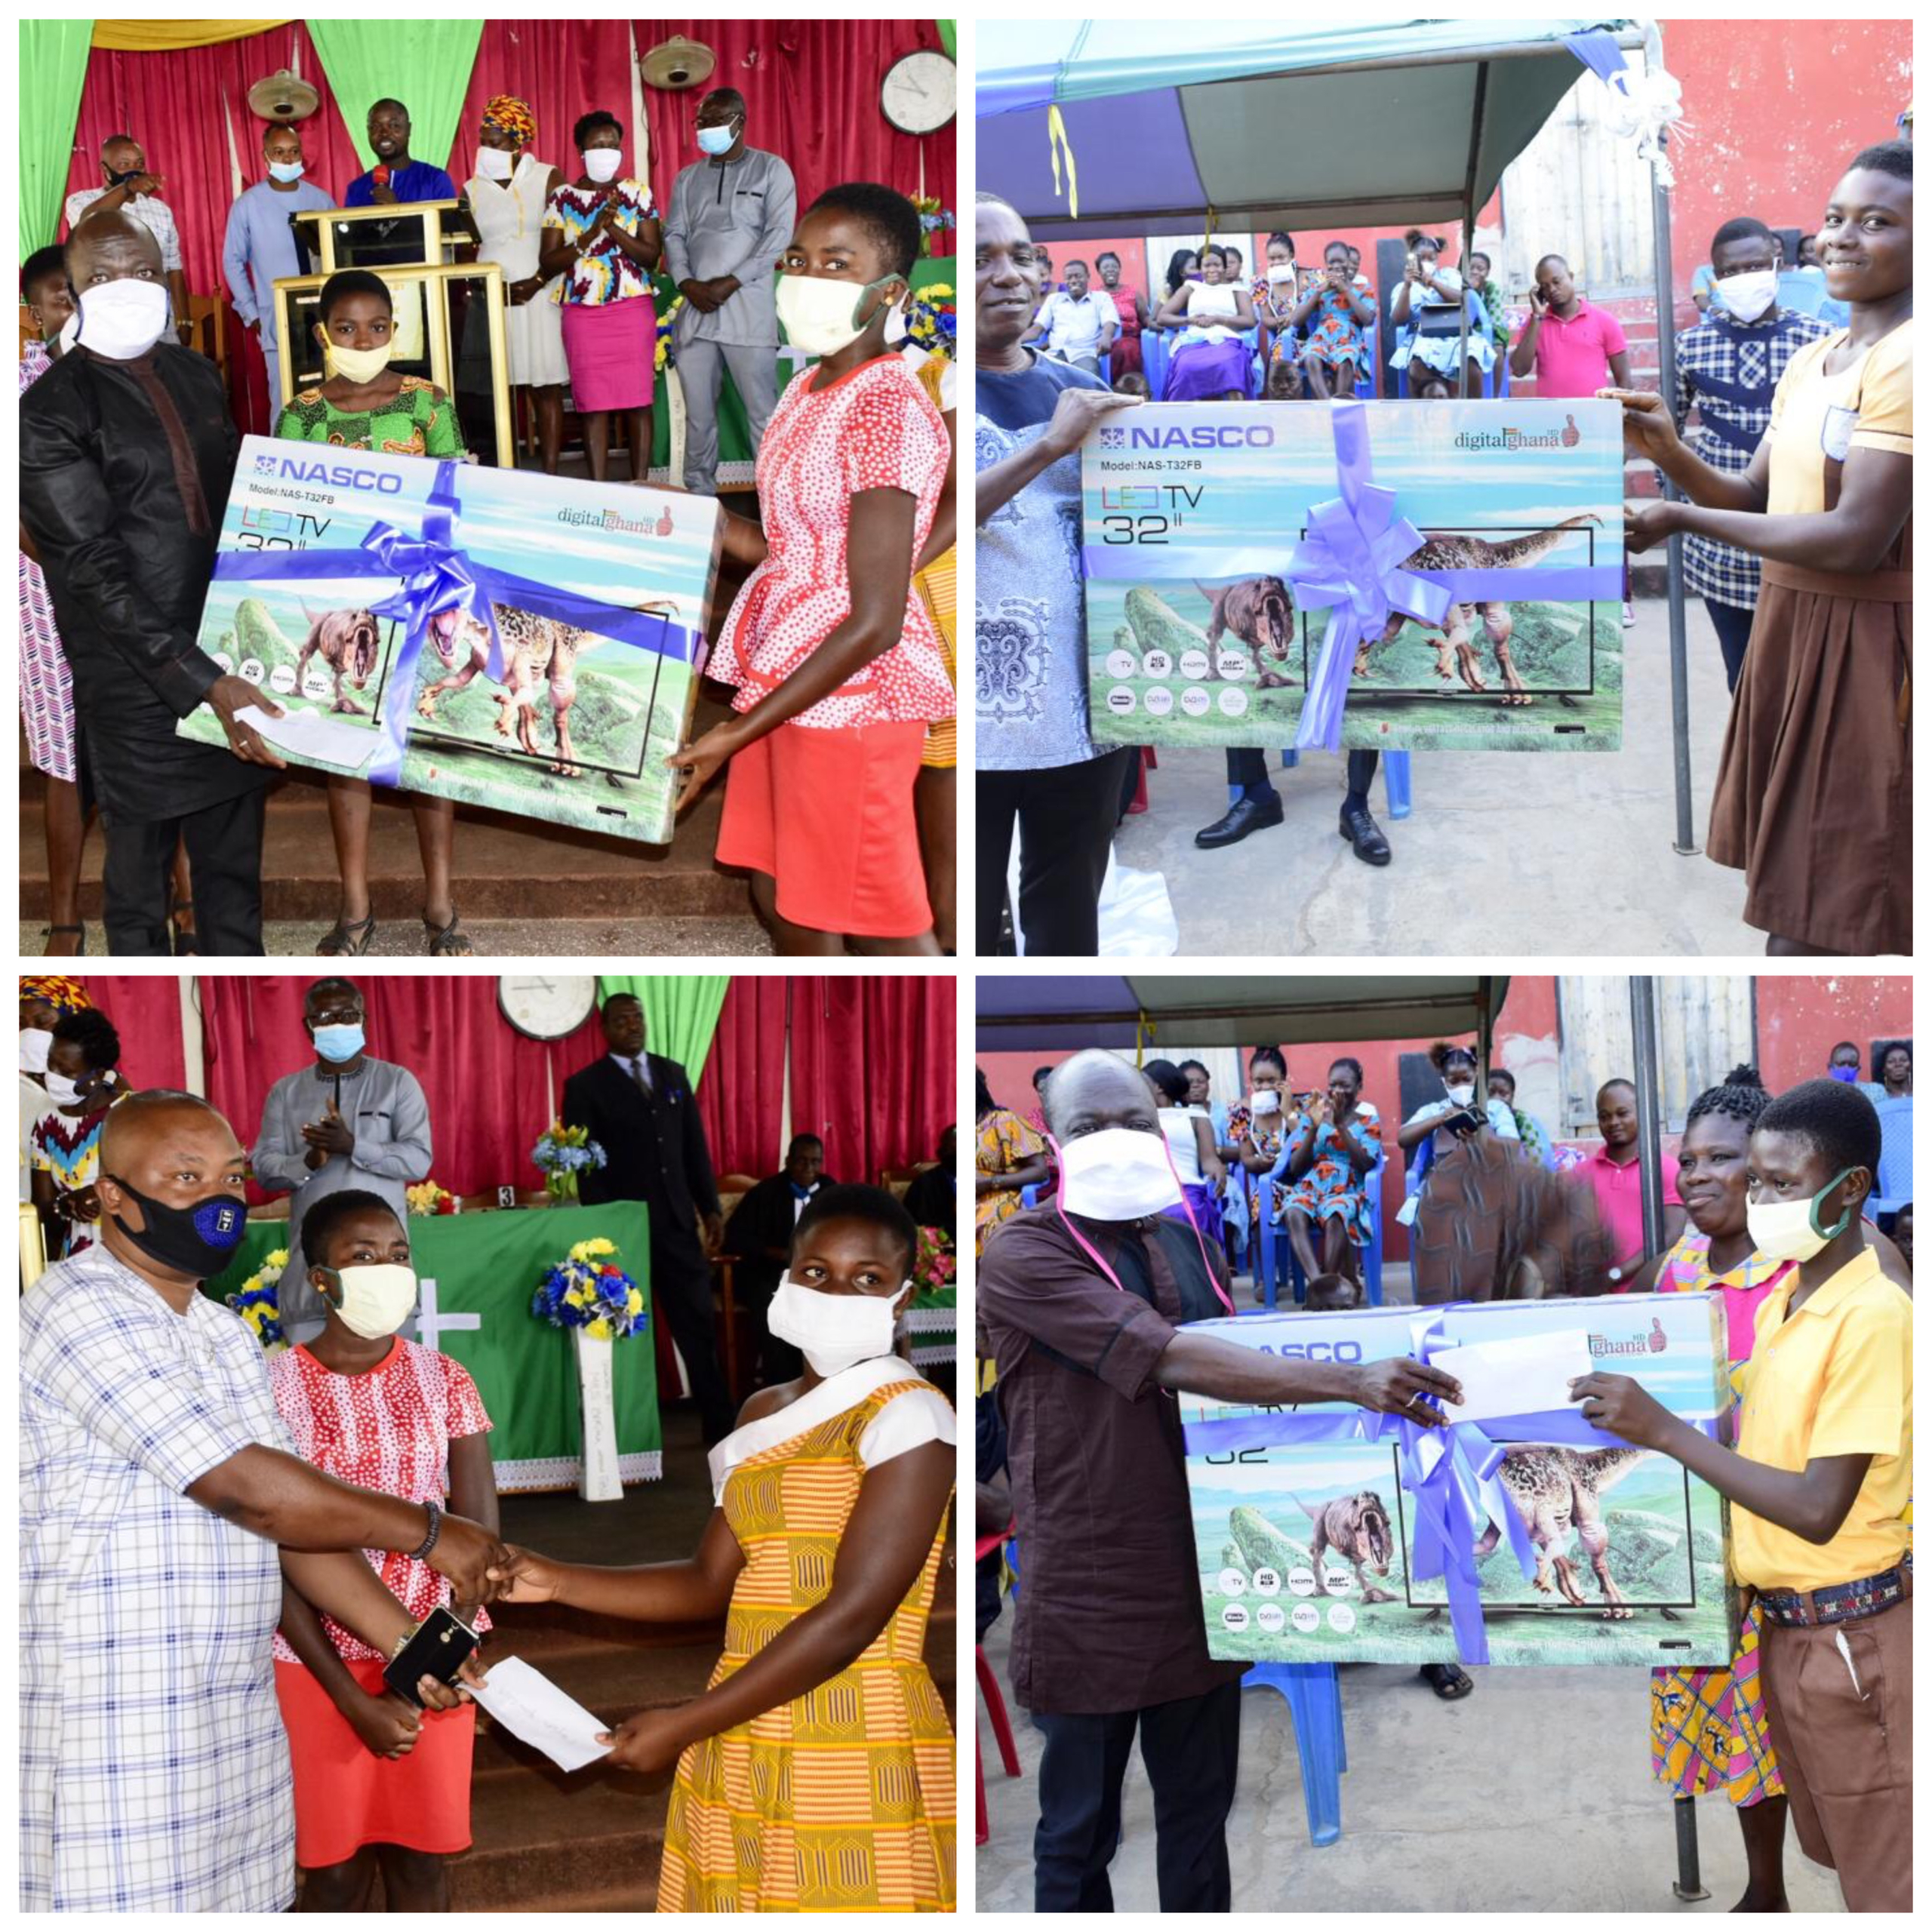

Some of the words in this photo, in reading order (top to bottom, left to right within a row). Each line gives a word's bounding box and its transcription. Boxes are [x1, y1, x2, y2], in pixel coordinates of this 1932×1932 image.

[1132, 425, 1275, 450] NASCO
[1454, 427, 1559, 451] digitalghana
[280, 459, 402, 494] NASCO
[1100, 460, 1202, 471] Model:NAS-T32FB
[1102, 485, 1159, 509] LED
[1162, 485, 1204, 509] TV
[242, 505, 293, 533] LED
[296, 513, 332, 538] TV
[502, 1187, 512, 1206] 3
